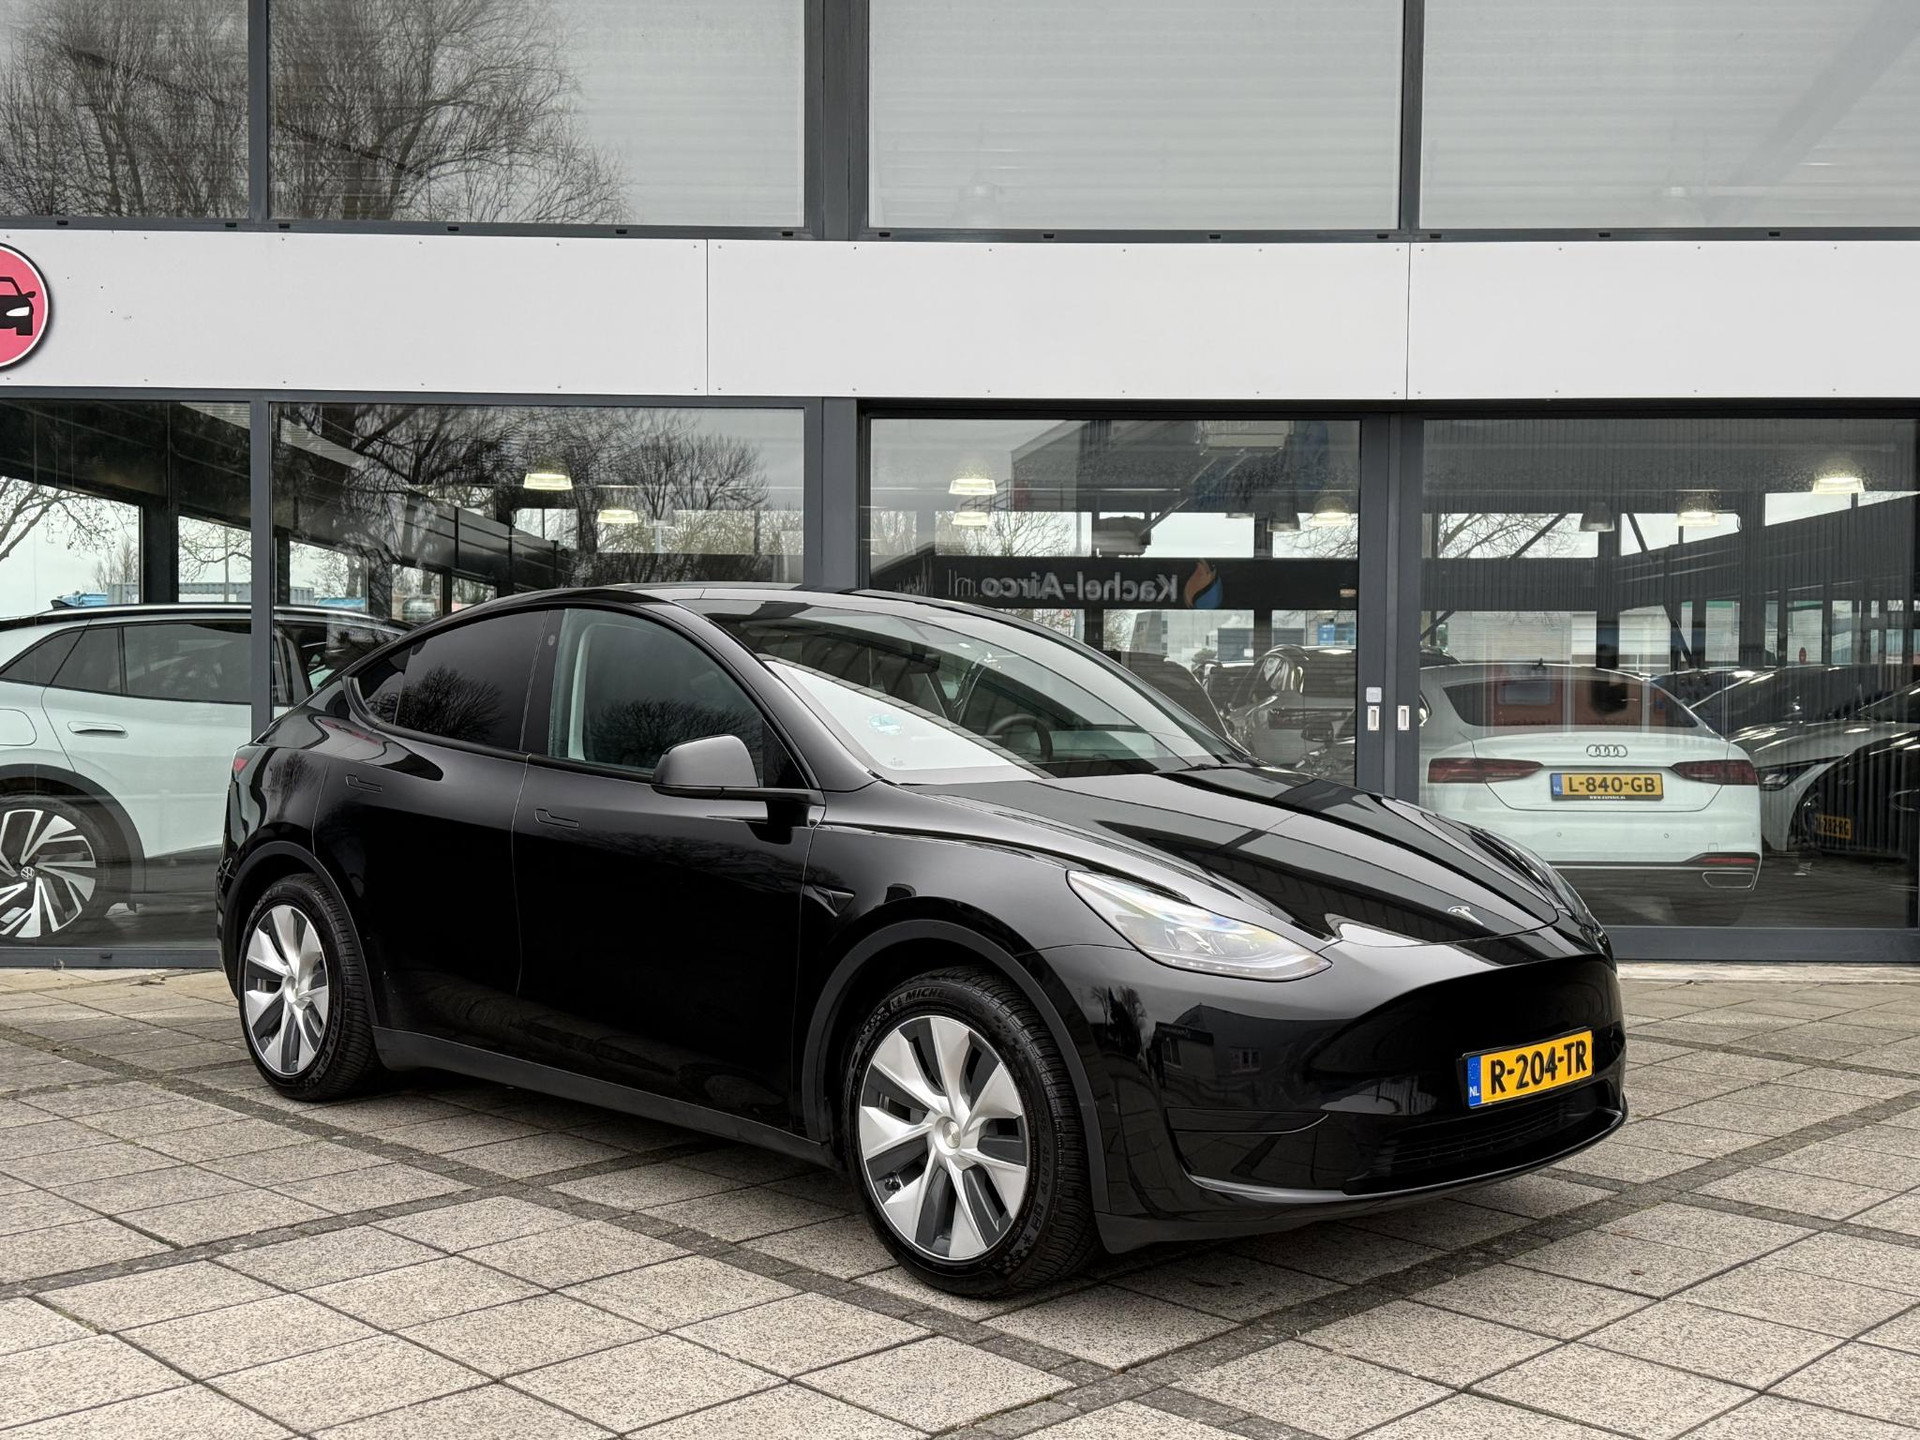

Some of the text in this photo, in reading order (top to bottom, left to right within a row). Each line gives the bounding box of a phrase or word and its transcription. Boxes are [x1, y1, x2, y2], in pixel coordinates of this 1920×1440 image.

[1568, 776, 1656, 793] L-840-GB
[1490, 1040, 1587, 1095] R-204-TR
[1469, 1086, 1480, 1097] NL
